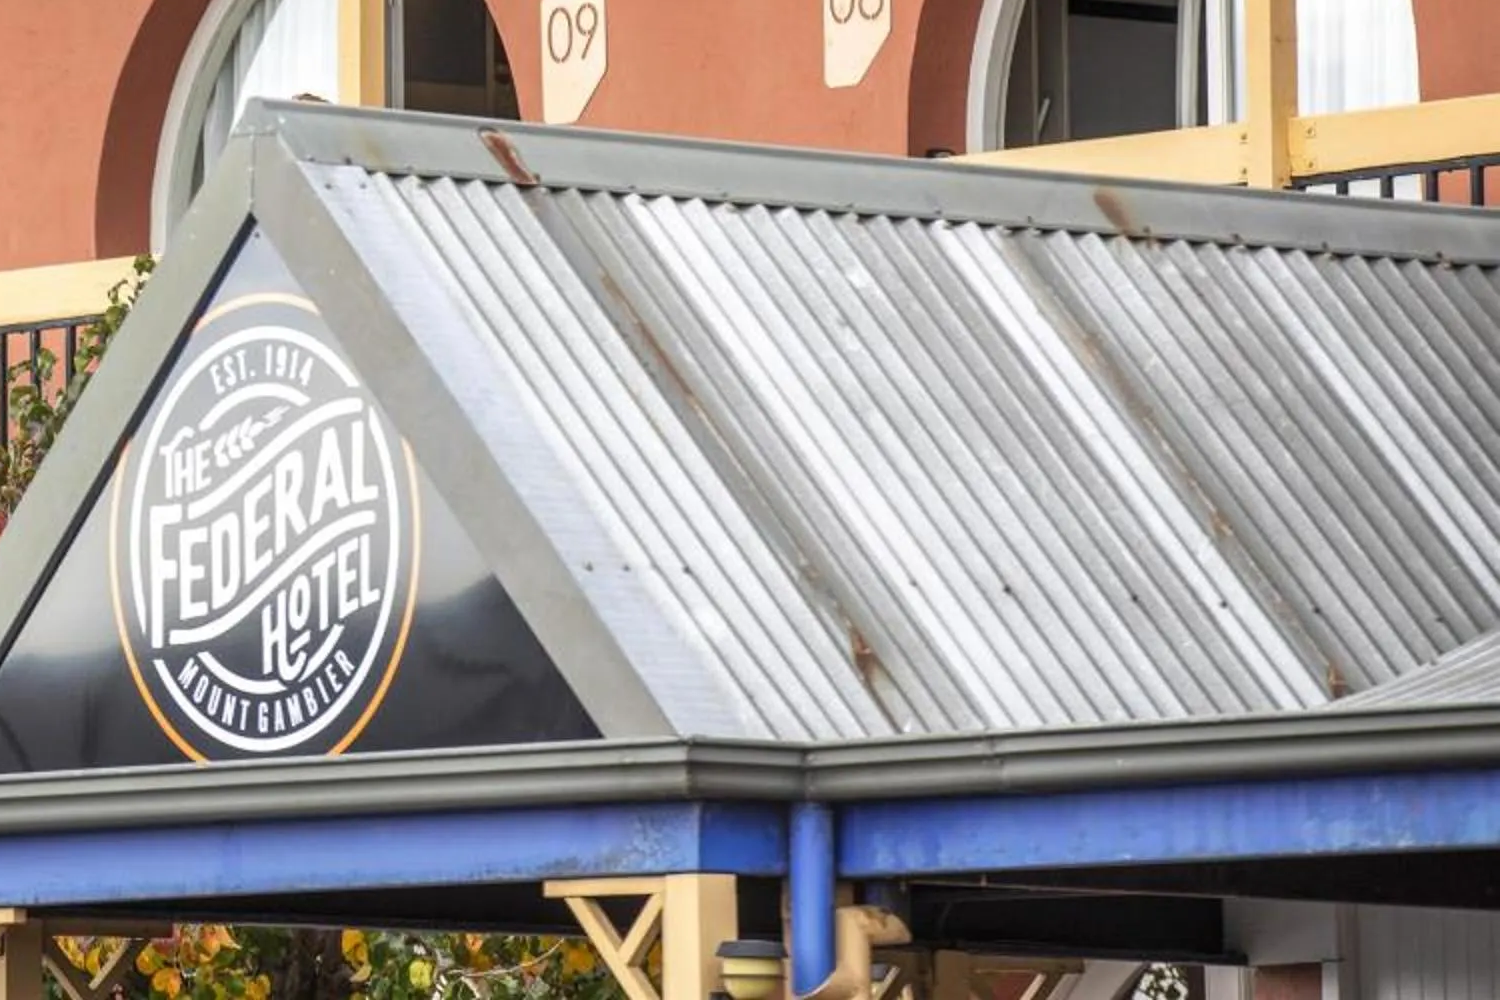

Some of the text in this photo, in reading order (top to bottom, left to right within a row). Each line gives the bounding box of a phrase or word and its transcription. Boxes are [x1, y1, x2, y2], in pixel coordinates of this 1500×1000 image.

[547, 2, 598, 63] 09
[211, 344, 313, 395] EST. 1914
[160, 426, 212, 498] THE
[149, 419, 378, 649] FEDERAL
[262, 533, 381, 682] HOTEL
[177, 649, 356, 733] MOUNT GAMBIER
